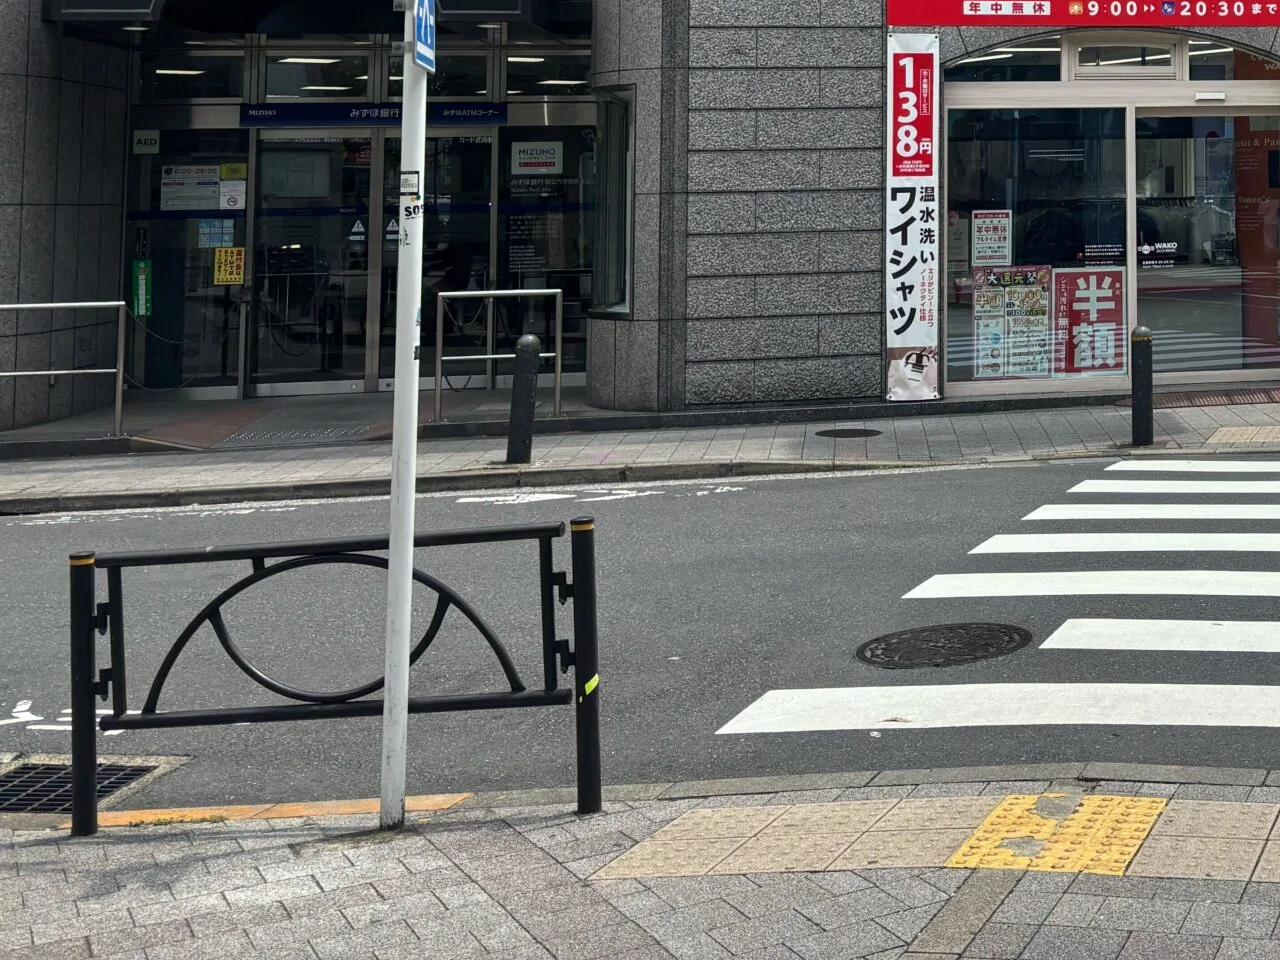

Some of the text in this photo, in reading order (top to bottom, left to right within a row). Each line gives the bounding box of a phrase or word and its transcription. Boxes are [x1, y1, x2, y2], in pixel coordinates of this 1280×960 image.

[967, 1, 1278, 17] 年中無休 9:00 20:30 まで
[248, 109, 277, 117] MIZUHO
[349, 108, 400, 118] みずほ銀行
[896, 56, 919, 158] 138
[919, 141, 932, 155] 円
[136, 138, 157, 146] AED
[518, 147, 556, 157] MIZUHO
[919, 186, 935, 264] 温水洗い
[976, 225, 1008, 234] 年中無休
[889, 186, 918, 336] ワイシャツ
[987, 271, 1038, 285] 大還元祭
[1072, 275, 1116, 368] 半額
